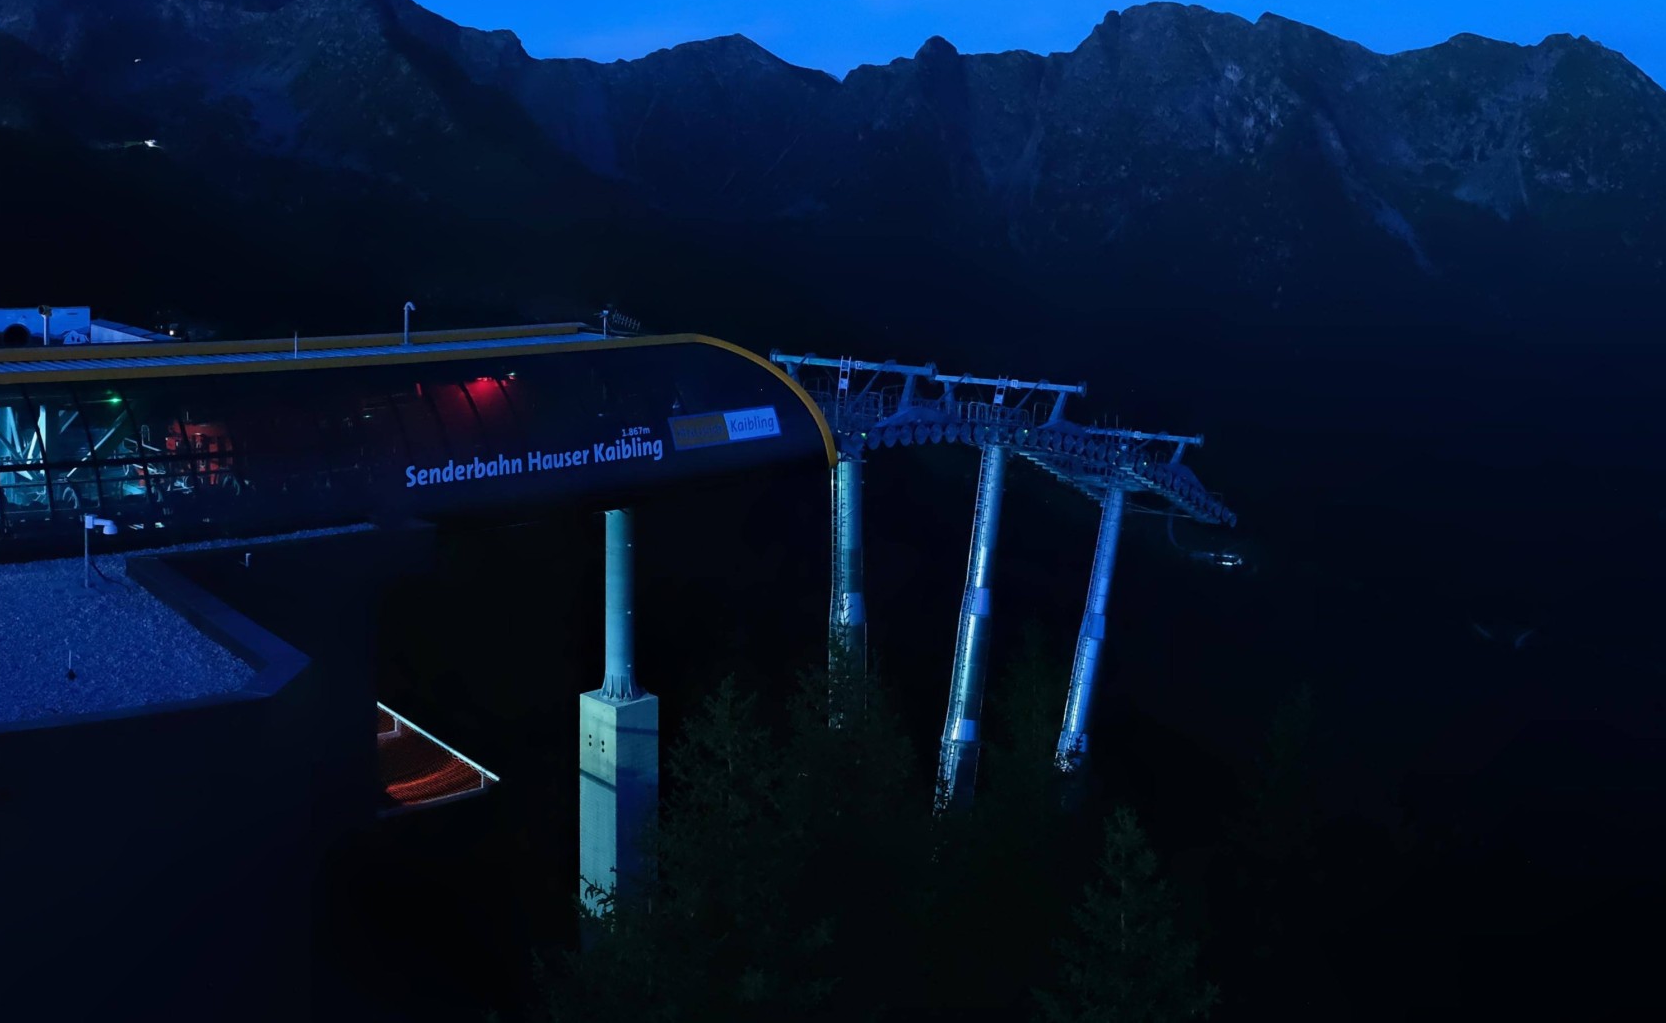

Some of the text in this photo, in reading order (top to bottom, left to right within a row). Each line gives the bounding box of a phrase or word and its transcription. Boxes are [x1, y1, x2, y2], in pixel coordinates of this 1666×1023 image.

[621, 426, 651, 438] 1.867m
[730, 415, 775, 432] Kaibling
[405, 437, 664, 488] Senderbahn Hauser Kaibling
